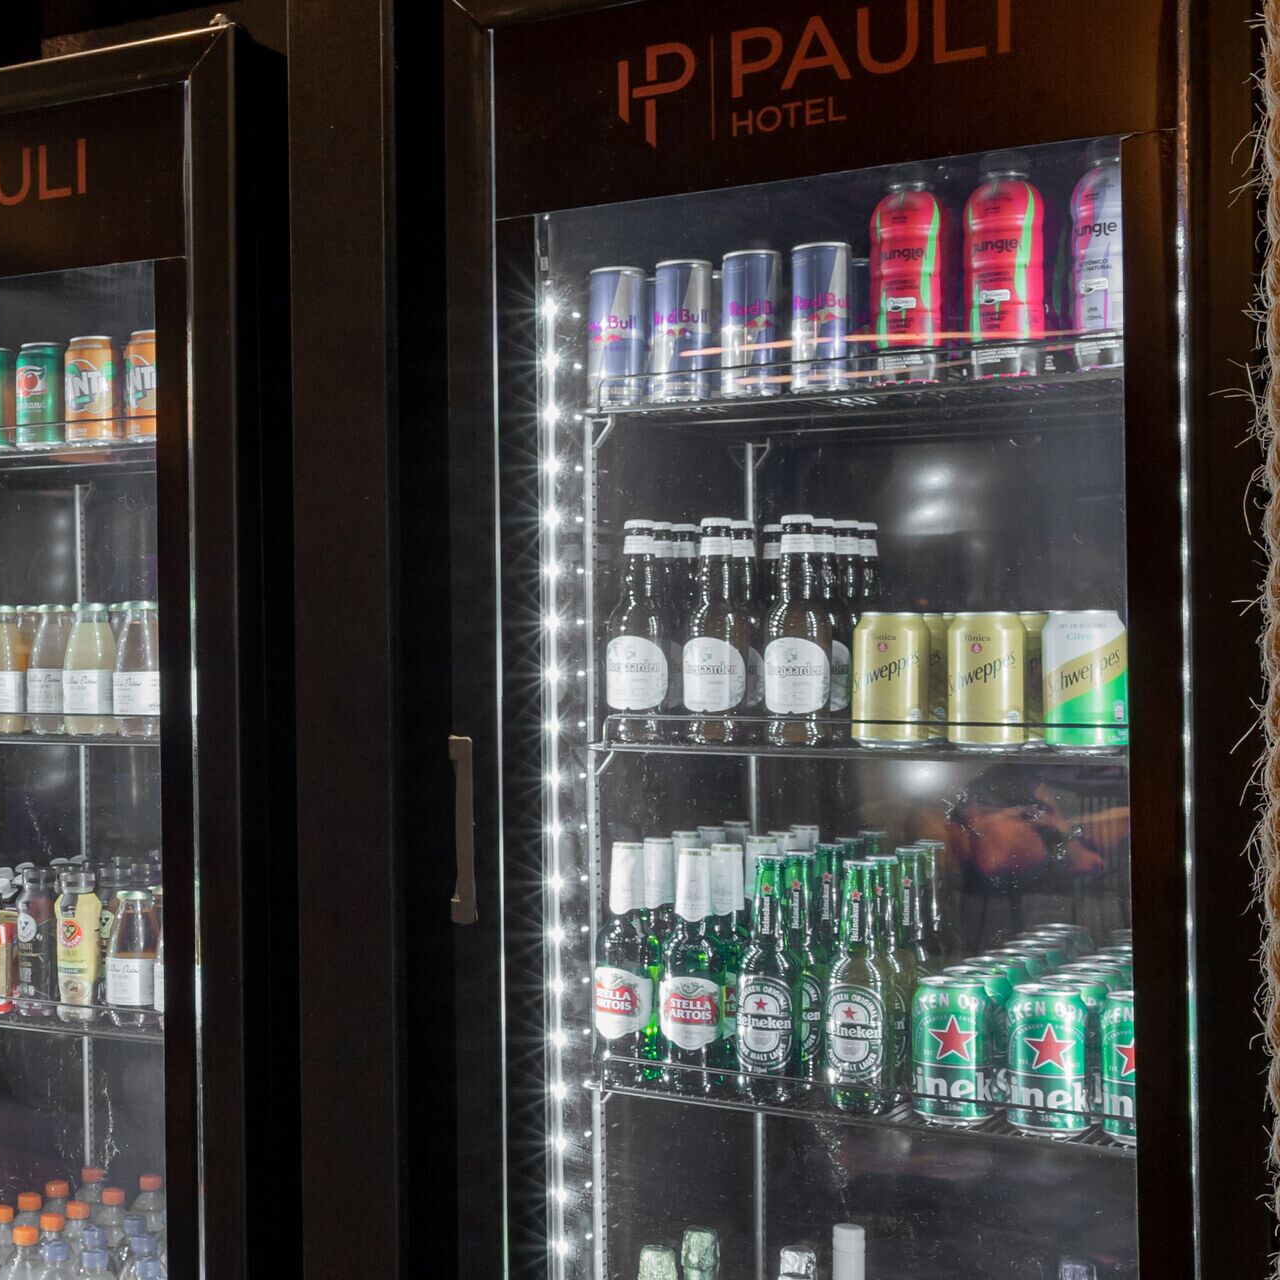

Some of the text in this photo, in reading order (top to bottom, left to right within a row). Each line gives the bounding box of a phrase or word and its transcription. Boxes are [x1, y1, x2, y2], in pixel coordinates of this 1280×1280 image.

[731, 97, 847, 138] HOTEL
[670, 998, 712, 1011] STELLA
[670, 1008, 713, 1021] ARTOIS
